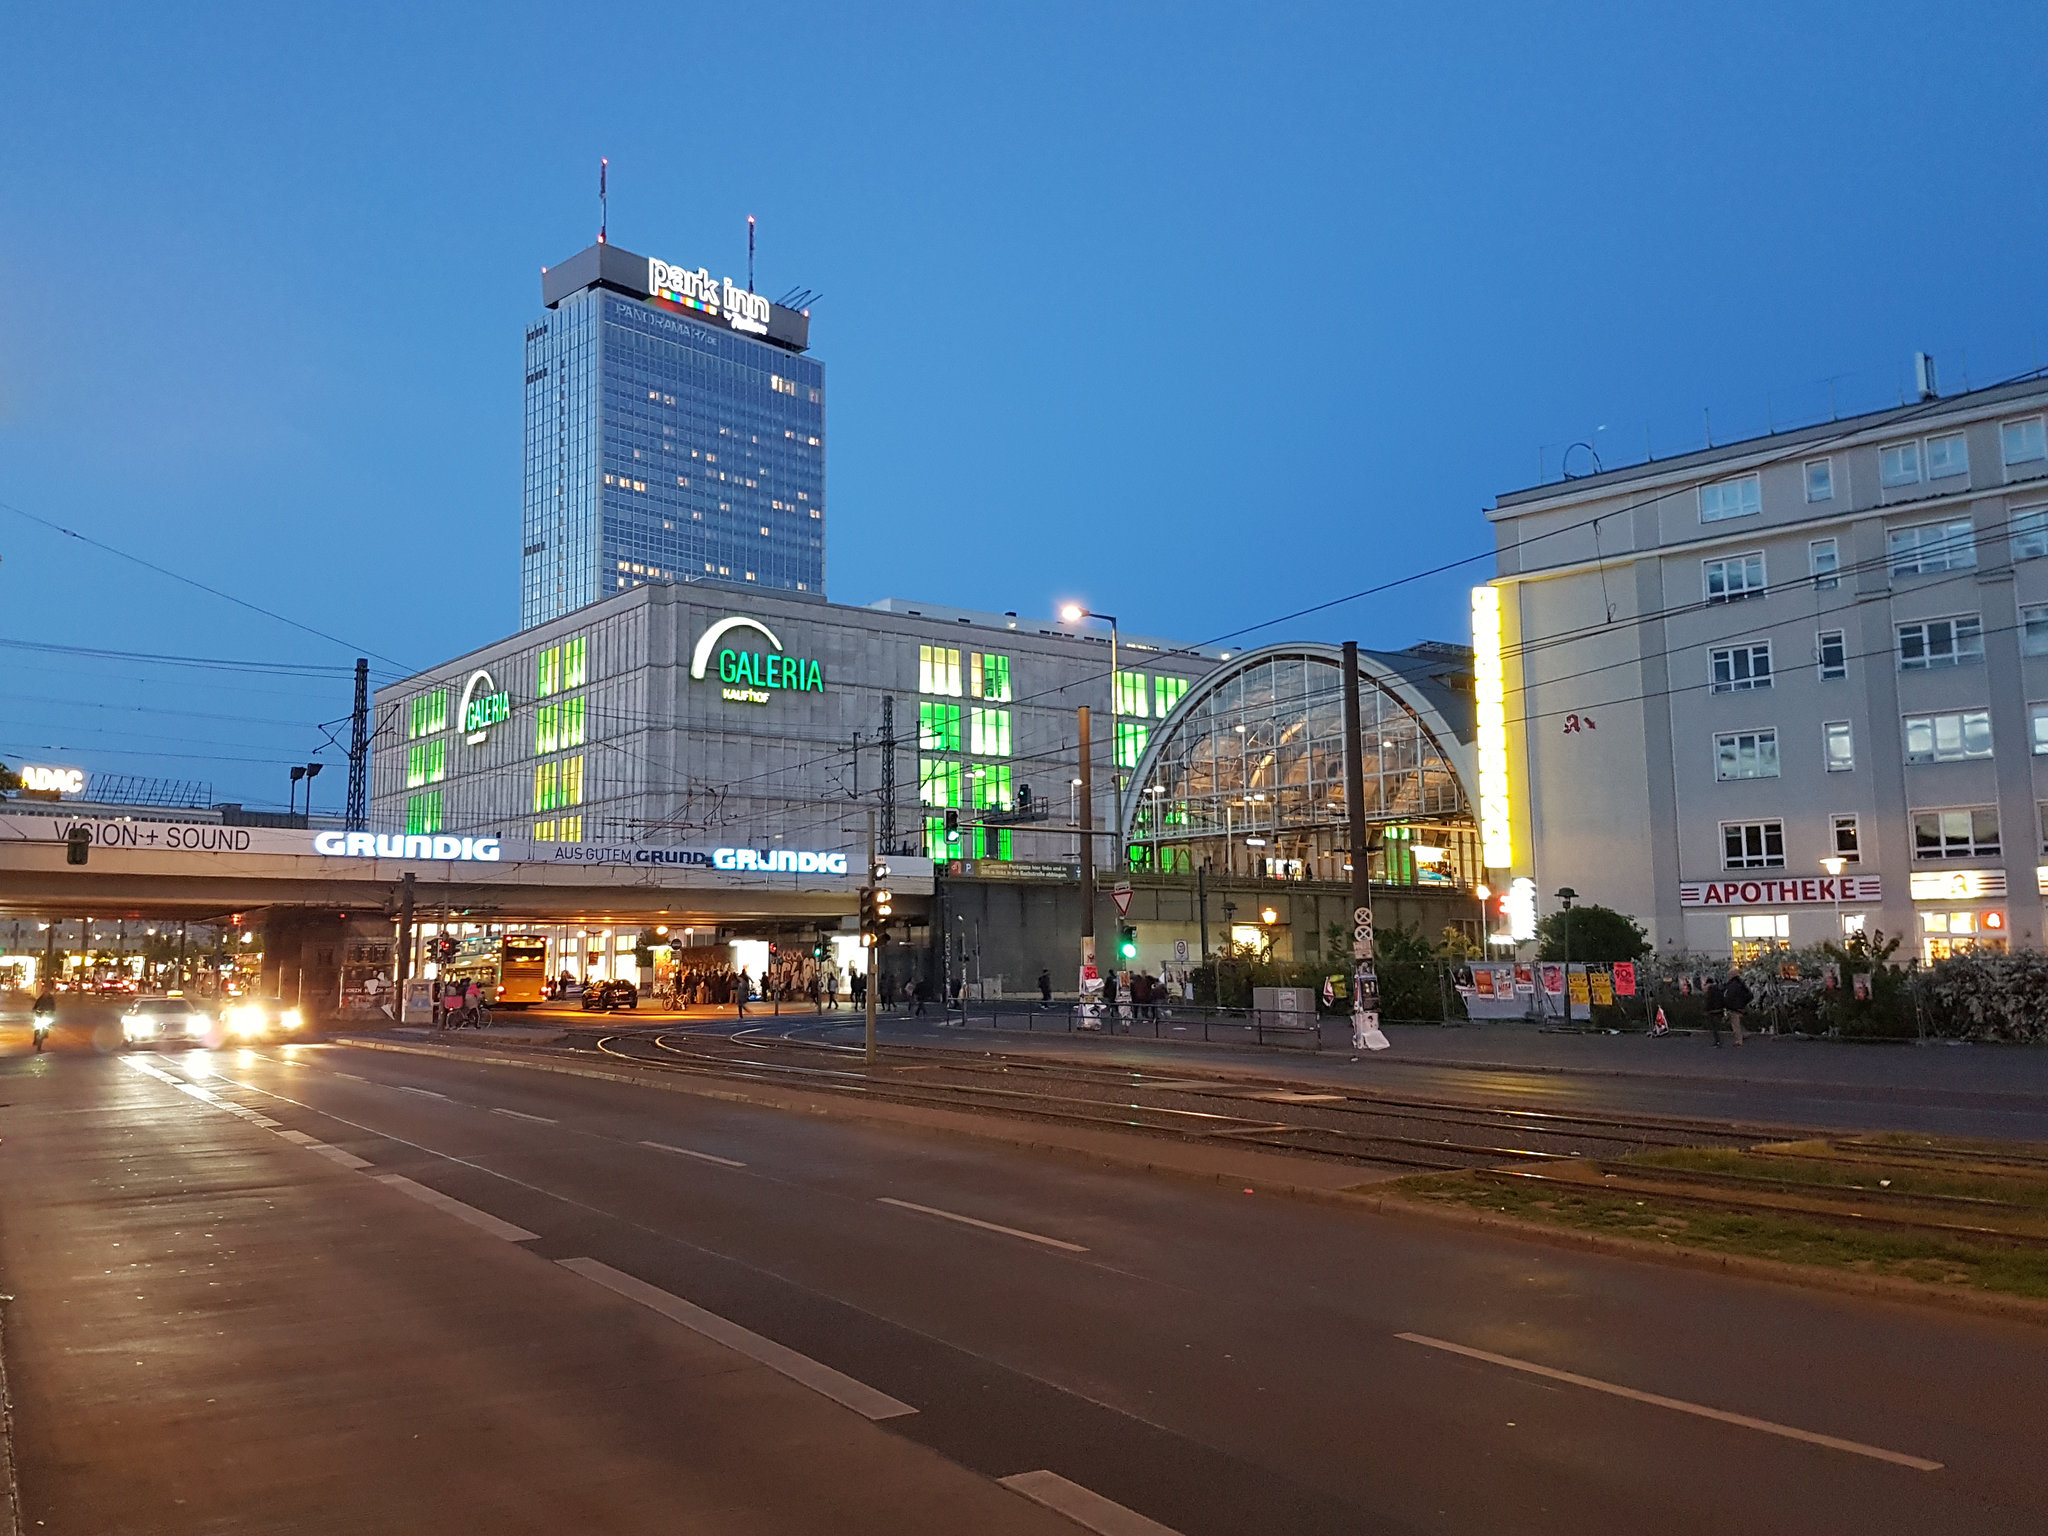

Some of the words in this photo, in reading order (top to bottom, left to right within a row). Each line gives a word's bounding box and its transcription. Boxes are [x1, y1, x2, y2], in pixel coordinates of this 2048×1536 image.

[649, 257, 720, 306] park
[723, 276, 770, 323] inn
[719, 648, 824, 693] GALERIA
[467, 690, 511, 732] GALERIA
[22, 766, 83, 793] ADAC
[166, 827, 251, 851] SOUND
[315, 831, 500, 862] GRUNDIG
[554, 847, 583, 861] AUS
[585, 848, 631, 863] GUTEM
[1704, 879, 1856, 904] APOTHEKE
